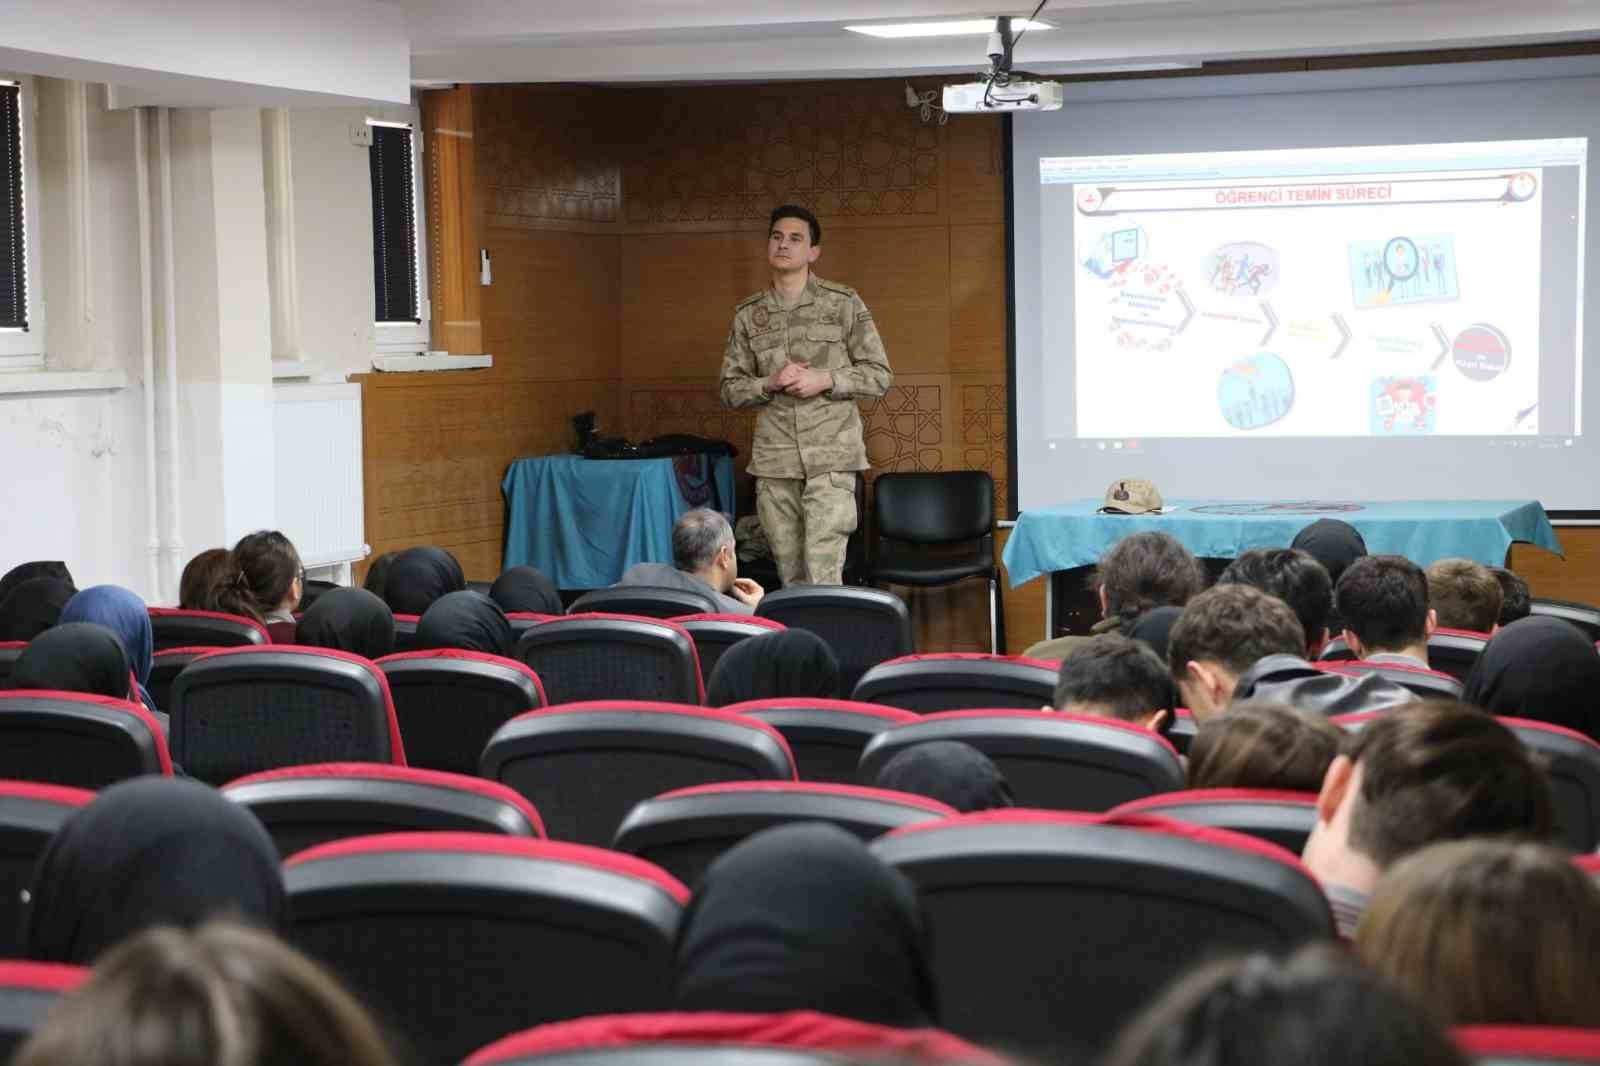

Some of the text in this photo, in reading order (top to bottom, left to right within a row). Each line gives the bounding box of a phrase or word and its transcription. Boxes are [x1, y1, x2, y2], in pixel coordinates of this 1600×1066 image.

[1215, 182, 1392, 204] ÖĞRENCİ TEMİN SÜRECİ
